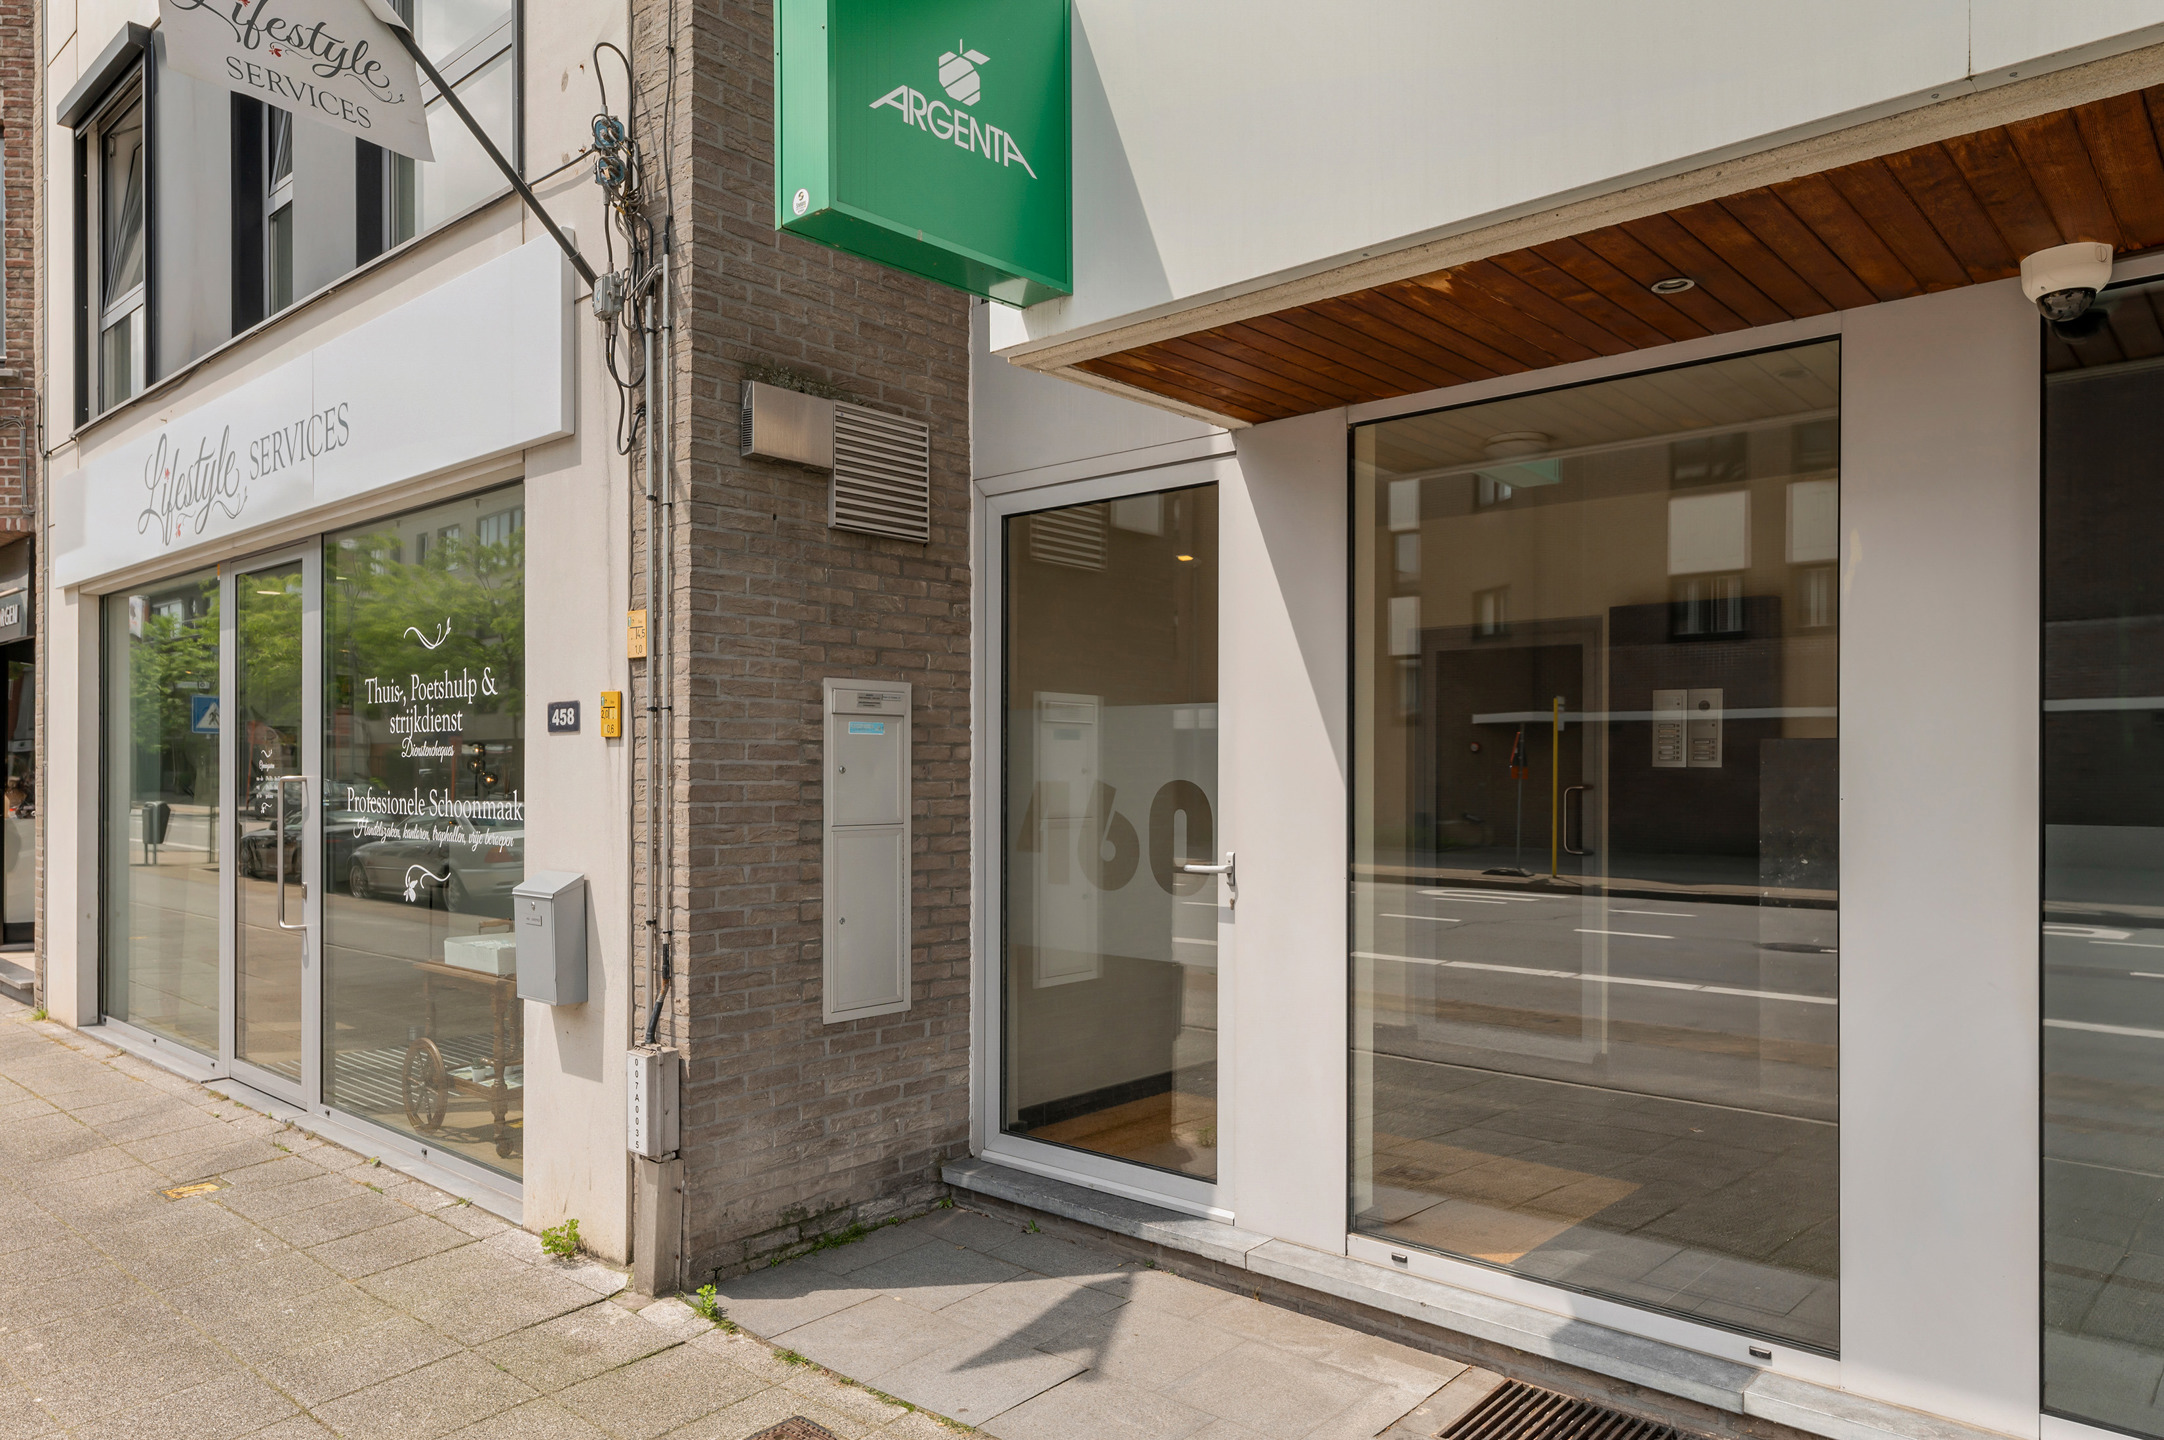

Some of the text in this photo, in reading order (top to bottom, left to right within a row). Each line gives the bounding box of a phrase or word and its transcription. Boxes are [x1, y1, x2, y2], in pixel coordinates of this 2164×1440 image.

[226, 55, 372, 129] SERVICES
[868, 84, 1038, 180] ARGENTA
[138, 402, 350, 546] Lifestyle SERVICES
[635, 644, 643, 656] 1,0
[364, 667, 498, 708] Thuis-, Poetshulp &
[389, 703, 463, 739] strijkdienst
[552, 708, 575, 726] 458
[606, 724, 614, 735] 0,6
[401, 736, 454, 763] Dienstencheques
[347, 786, 524, 822] Professionele Schoonmaak
[484, 828, 514, 853] beroepen
